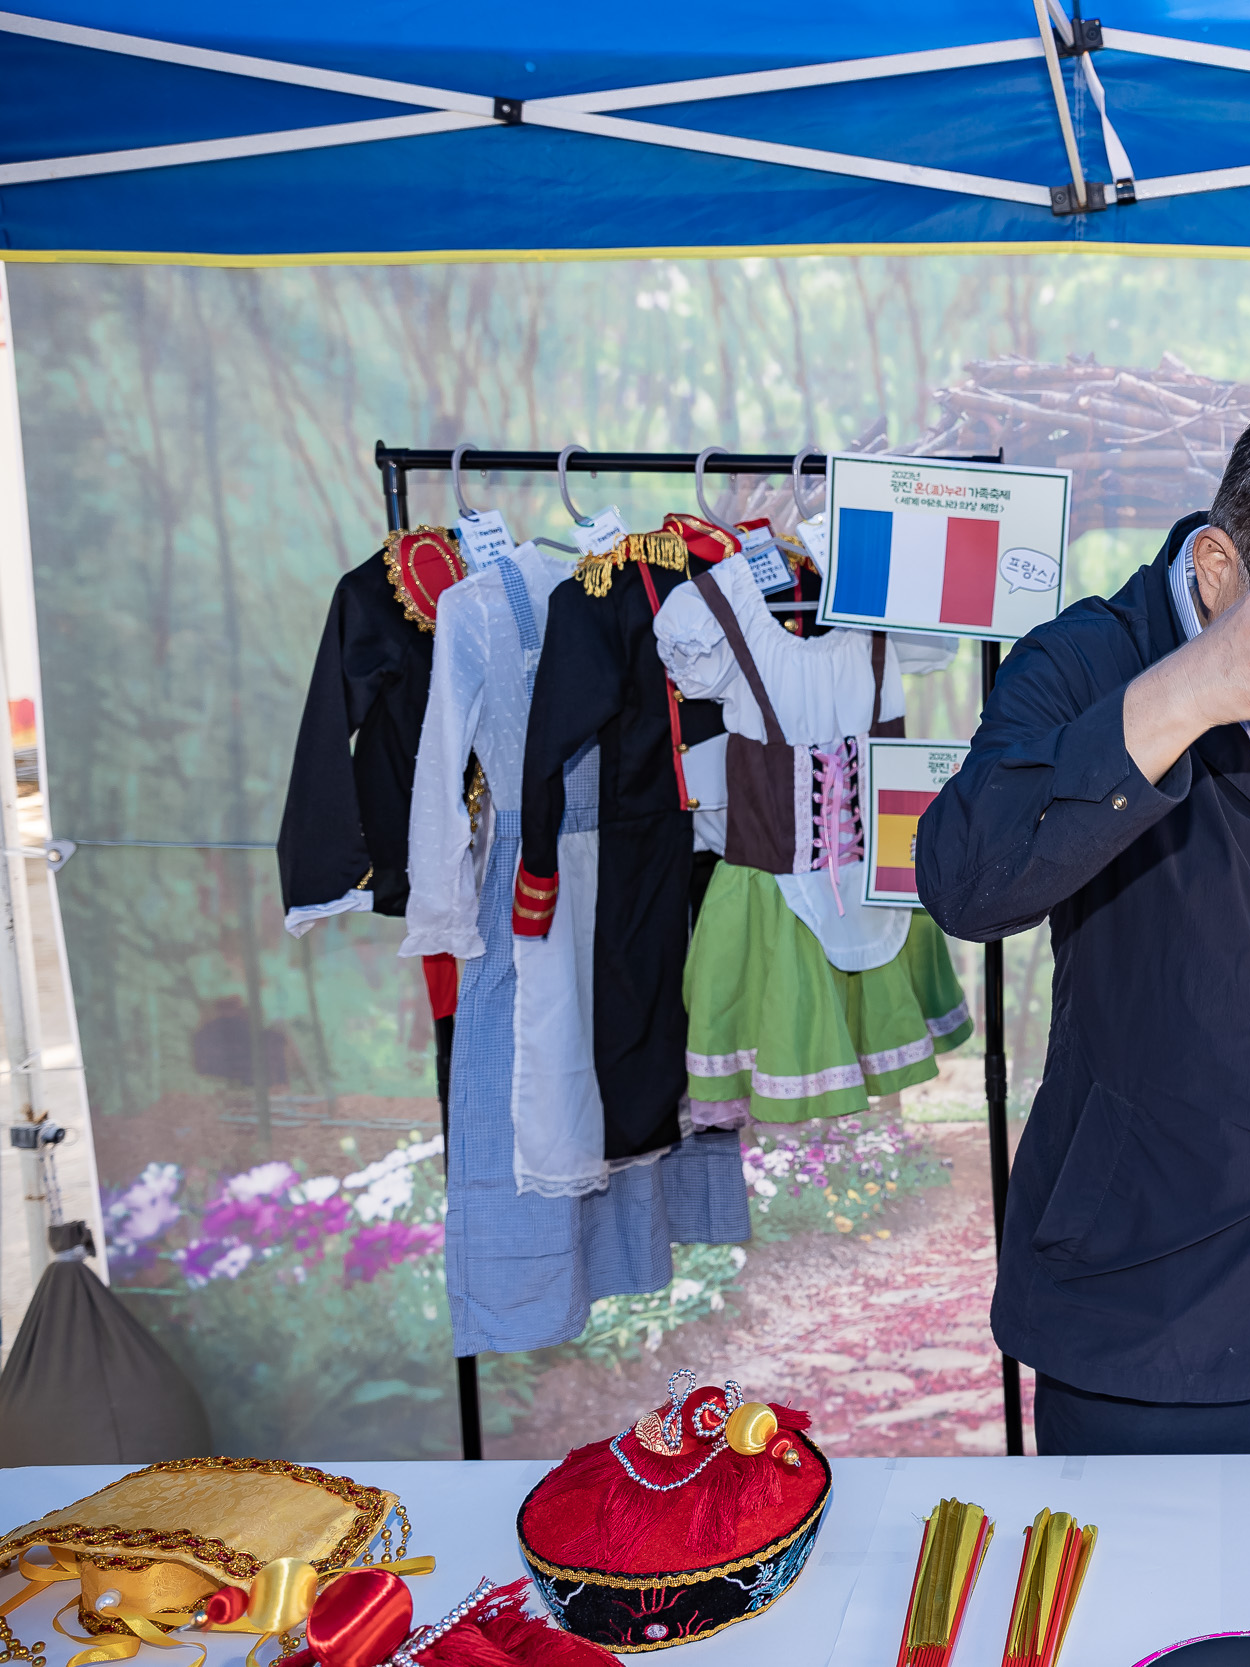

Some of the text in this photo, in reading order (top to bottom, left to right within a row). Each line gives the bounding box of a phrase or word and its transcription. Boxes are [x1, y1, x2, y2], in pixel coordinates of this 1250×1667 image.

[891, 471, 920, 481] 2023년
[890, 480, 913, 493] 광진
[968, 487, 1011, 500] 가족축제
[1006, 557, 1056, 587] 프랑스!
